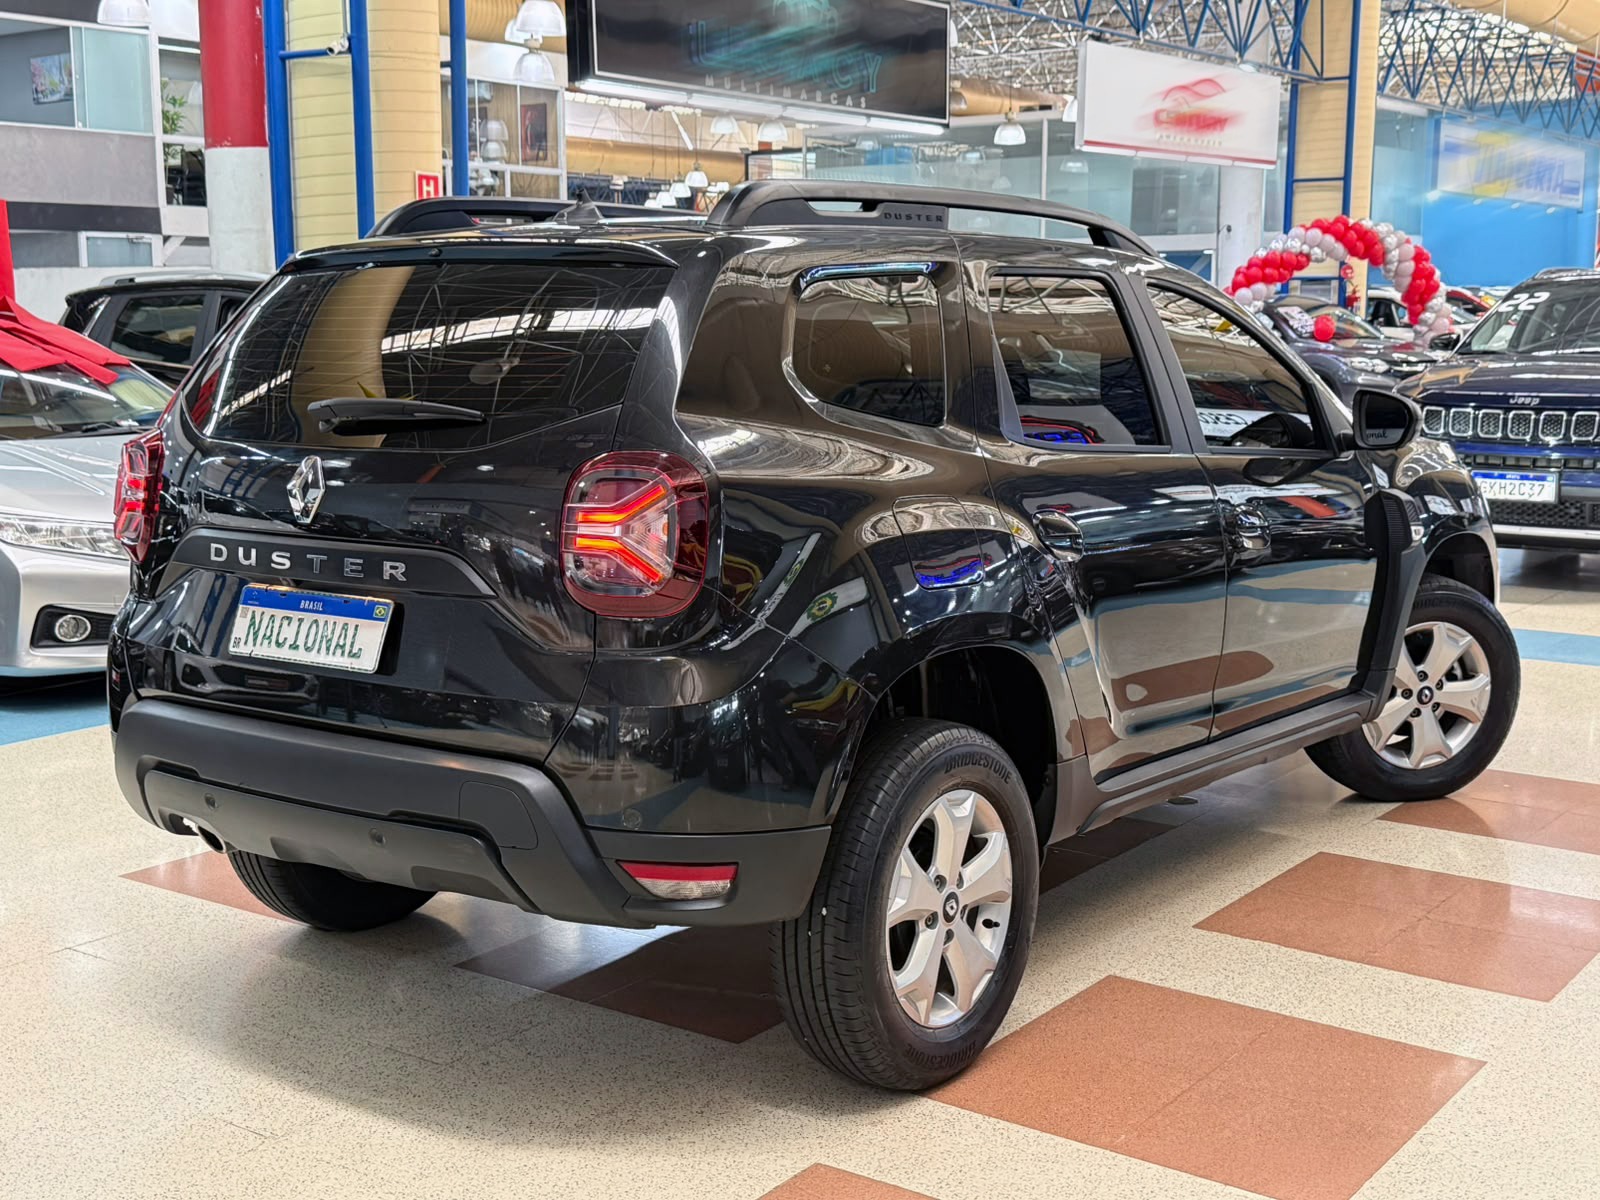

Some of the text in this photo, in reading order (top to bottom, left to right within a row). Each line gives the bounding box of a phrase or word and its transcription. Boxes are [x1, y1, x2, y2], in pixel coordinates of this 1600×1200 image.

[704, 73, 868, 109] MULTIMARCAS
[422, 178, 435, 198] H
[884, 211, 944, 223] DUSTER
[1498, 291, 1551, 312] 22
[1509, 395, 1540, 407] Jeep
[210, 542, 407, 582] DUSTER
[299, 600, 324, 612] BRASIL
[232, 636, 242, 649] BR
[243, 610, 363, 660] NACIONAL
[944, 751, 1013, 785] BRIDGESTONE
